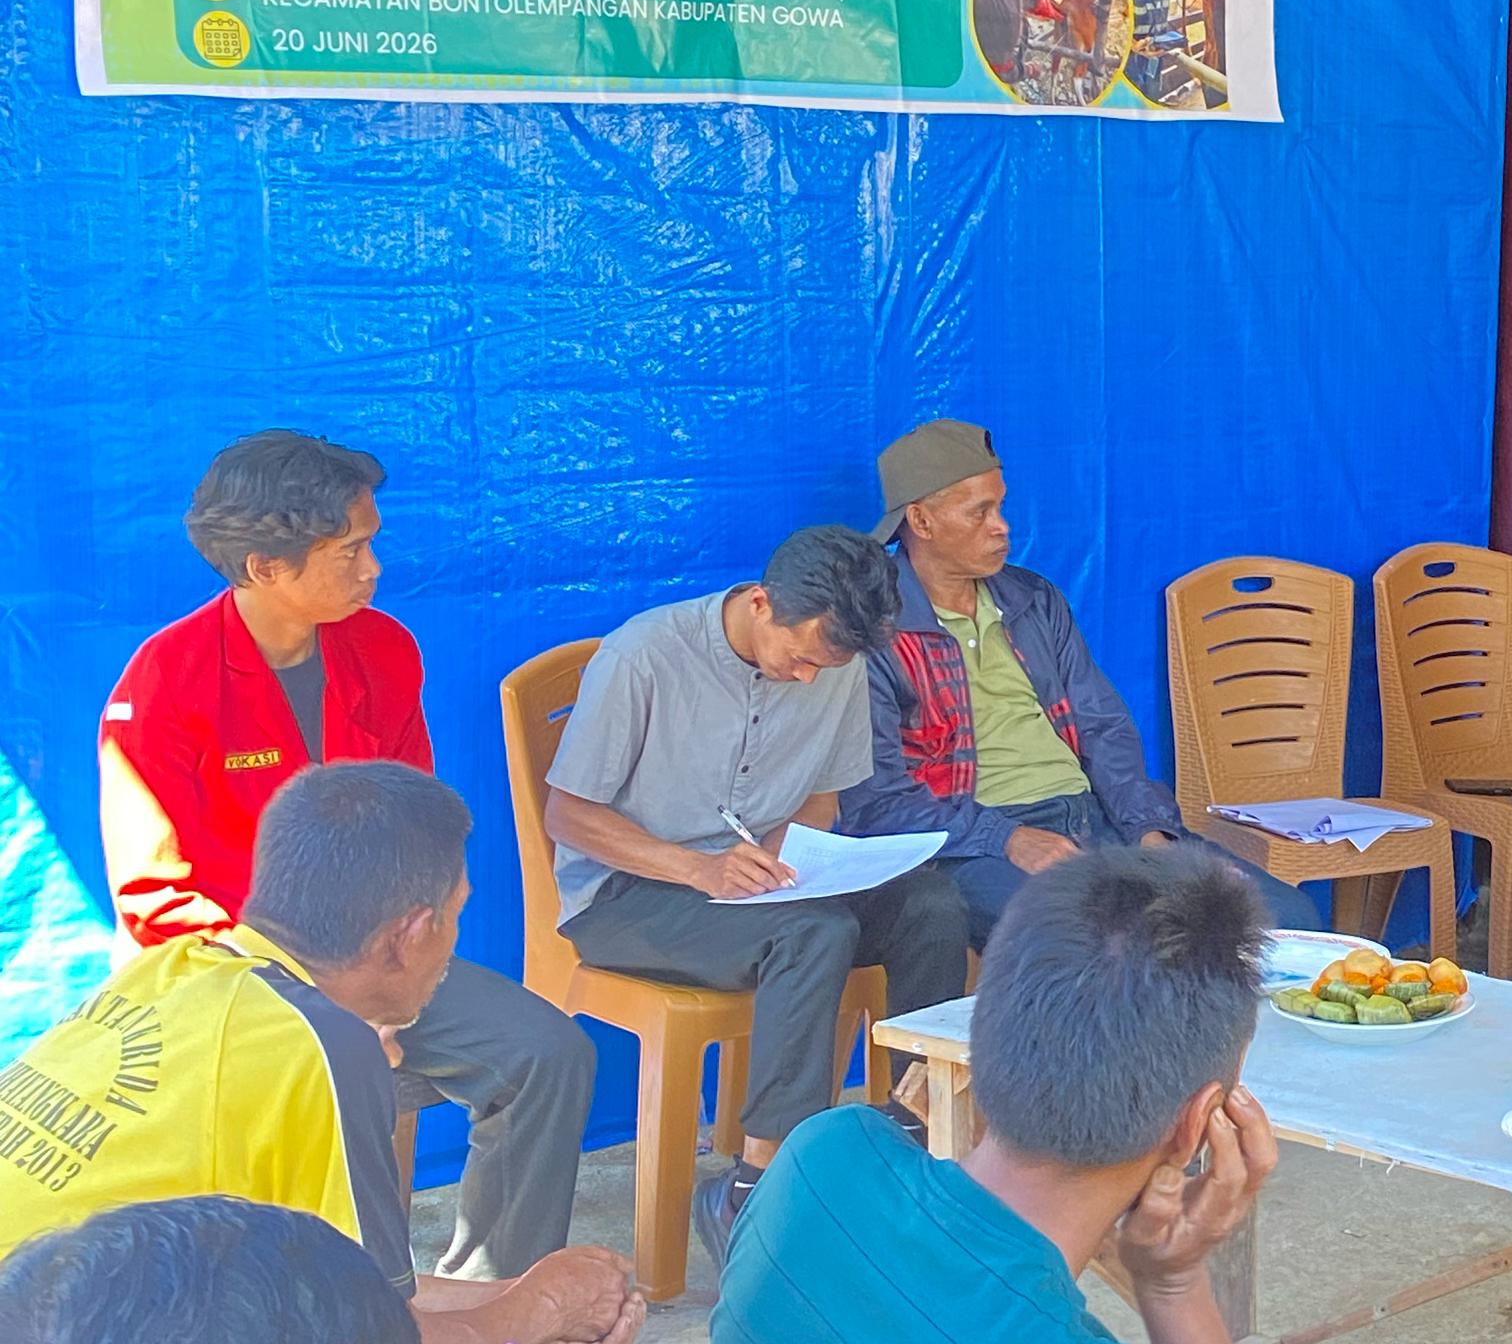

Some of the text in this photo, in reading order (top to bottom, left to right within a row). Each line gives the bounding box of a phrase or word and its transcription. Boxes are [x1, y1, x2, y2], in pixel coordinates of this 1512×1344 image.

[654, 0, 765, 23] KABUPATEN
[773, 7, 844, 29] GOWA
[272, 29, 437, 54] 20 JUNI 2026
[228, 751, 275, 768] VOKASI
[15, 1138, 82, 1192] 2013
